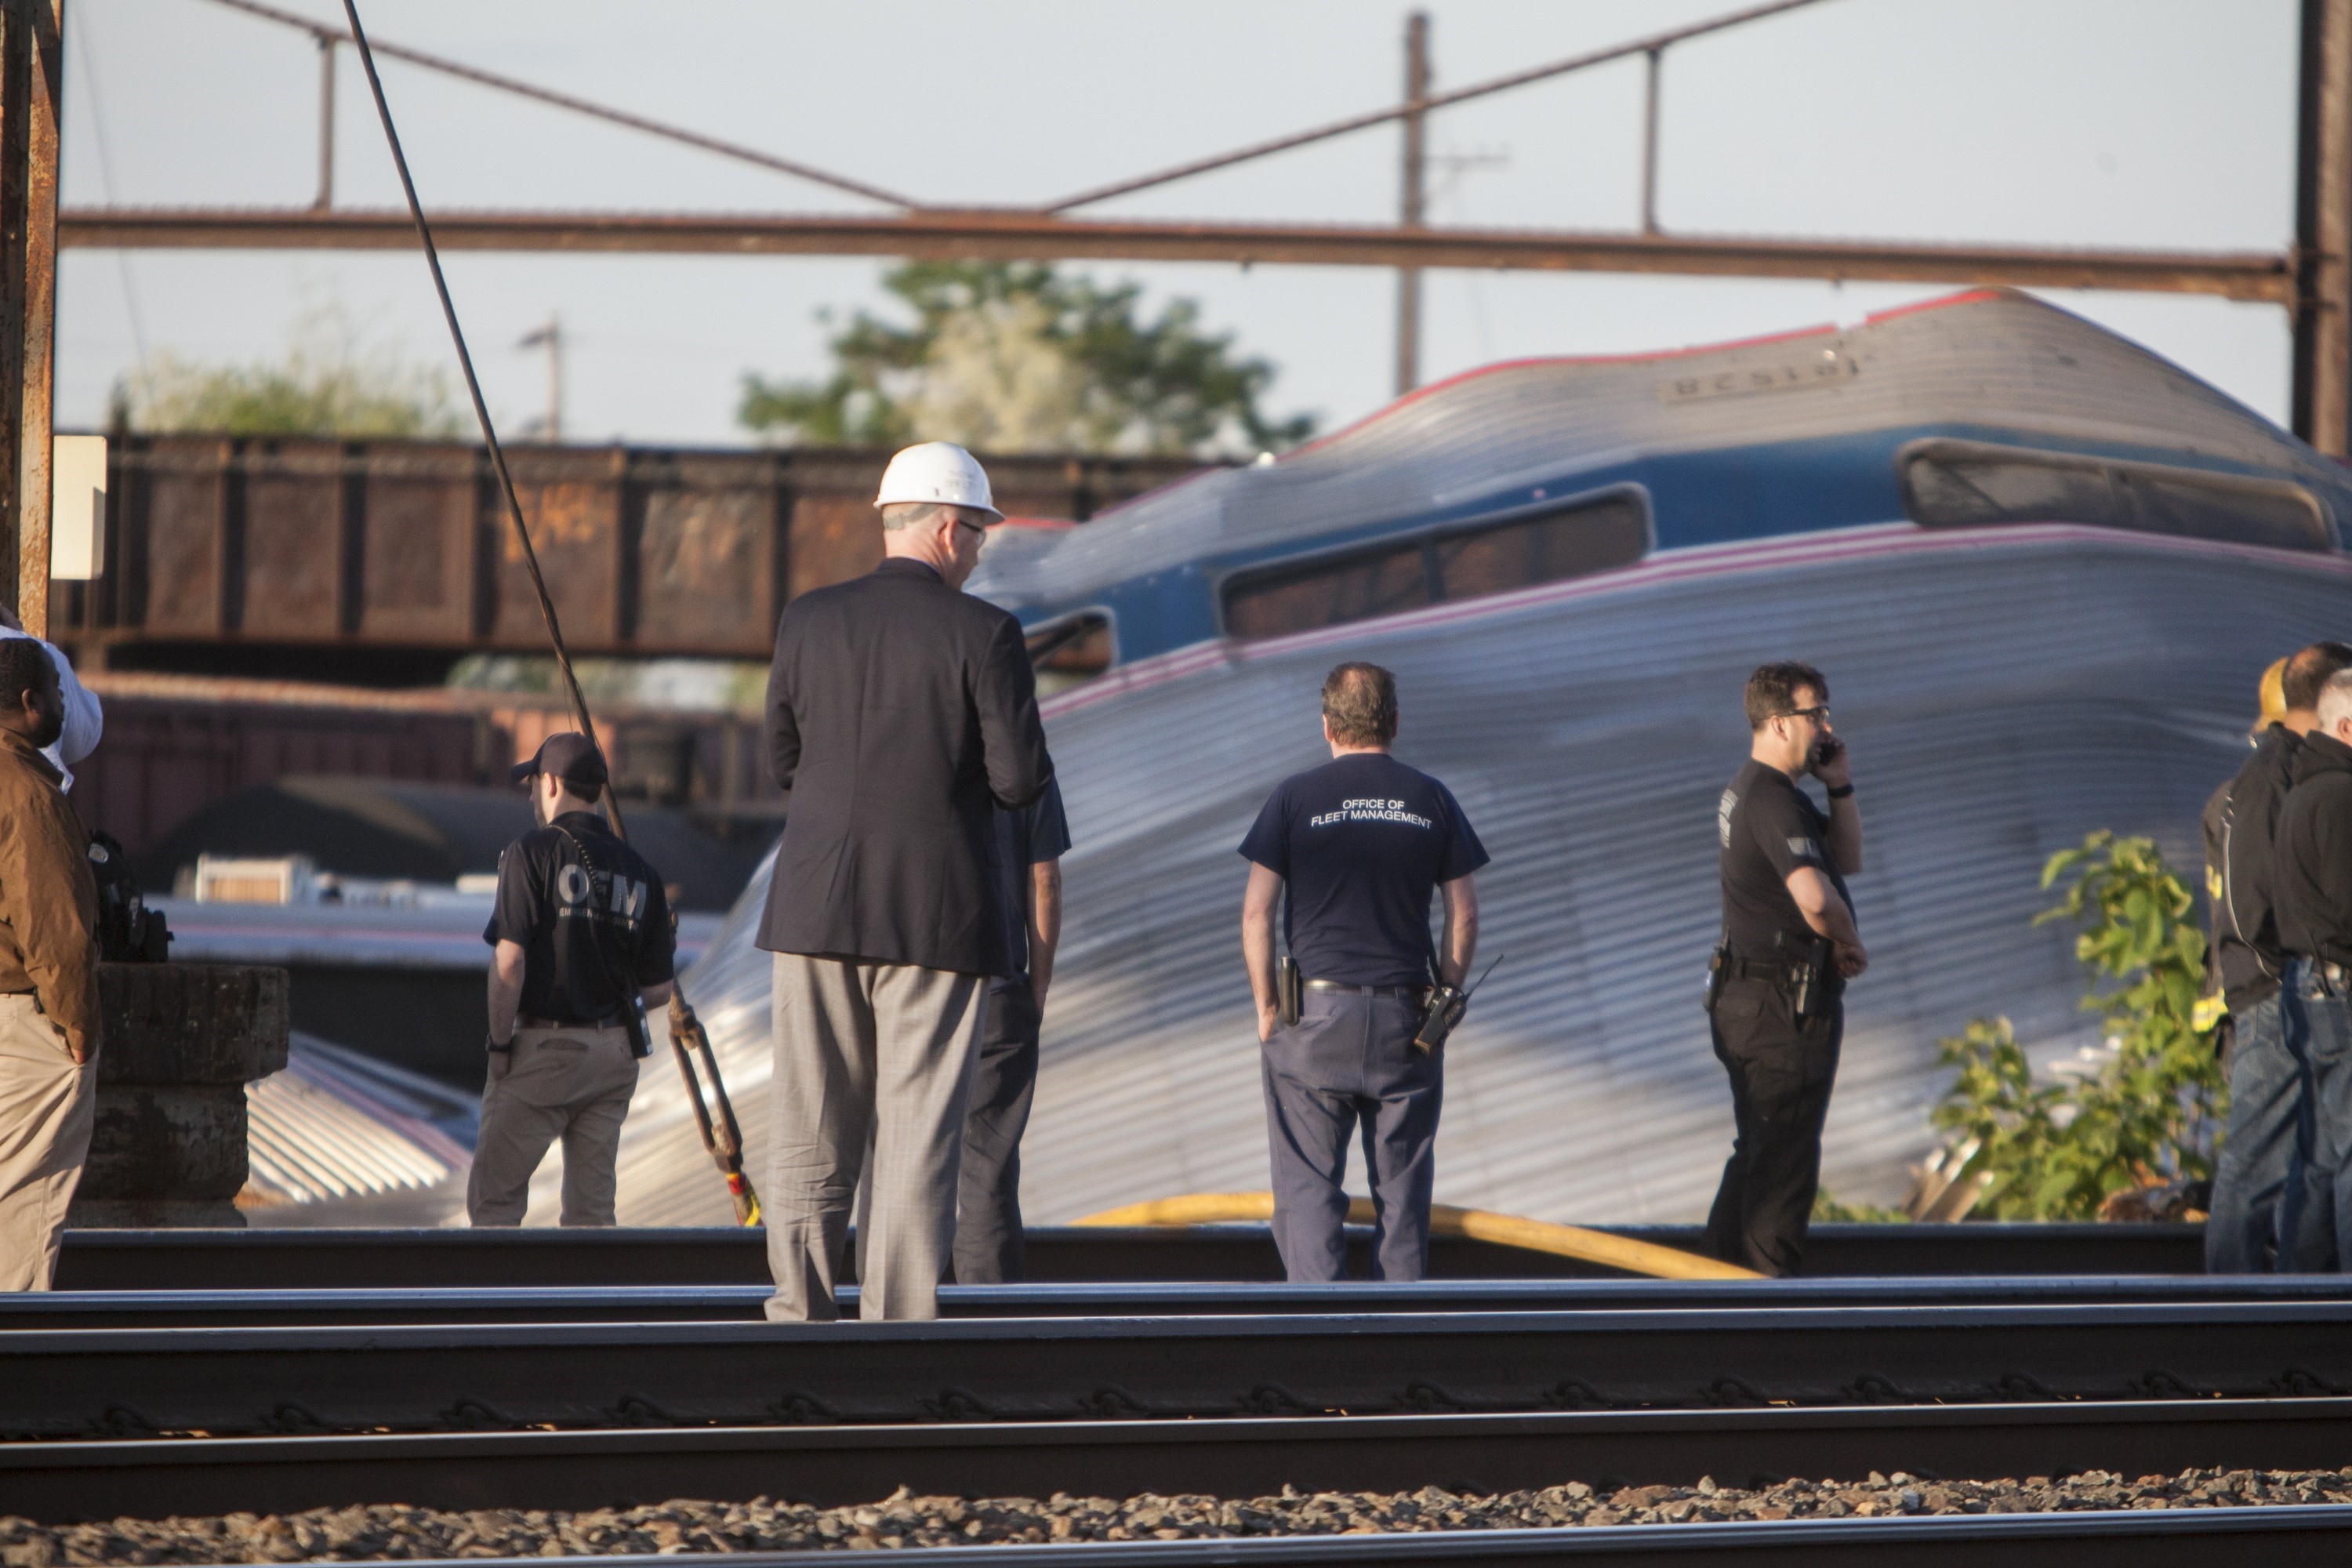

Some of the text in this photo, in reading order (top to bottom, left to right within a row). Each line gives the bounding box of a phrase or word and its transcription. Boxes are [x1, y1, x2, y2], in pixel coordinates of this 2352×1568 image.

[1342, 799, 1405, 811] OFFICE OF
[1311, 810, 1432, 829] FLEET MANAGEMENT
